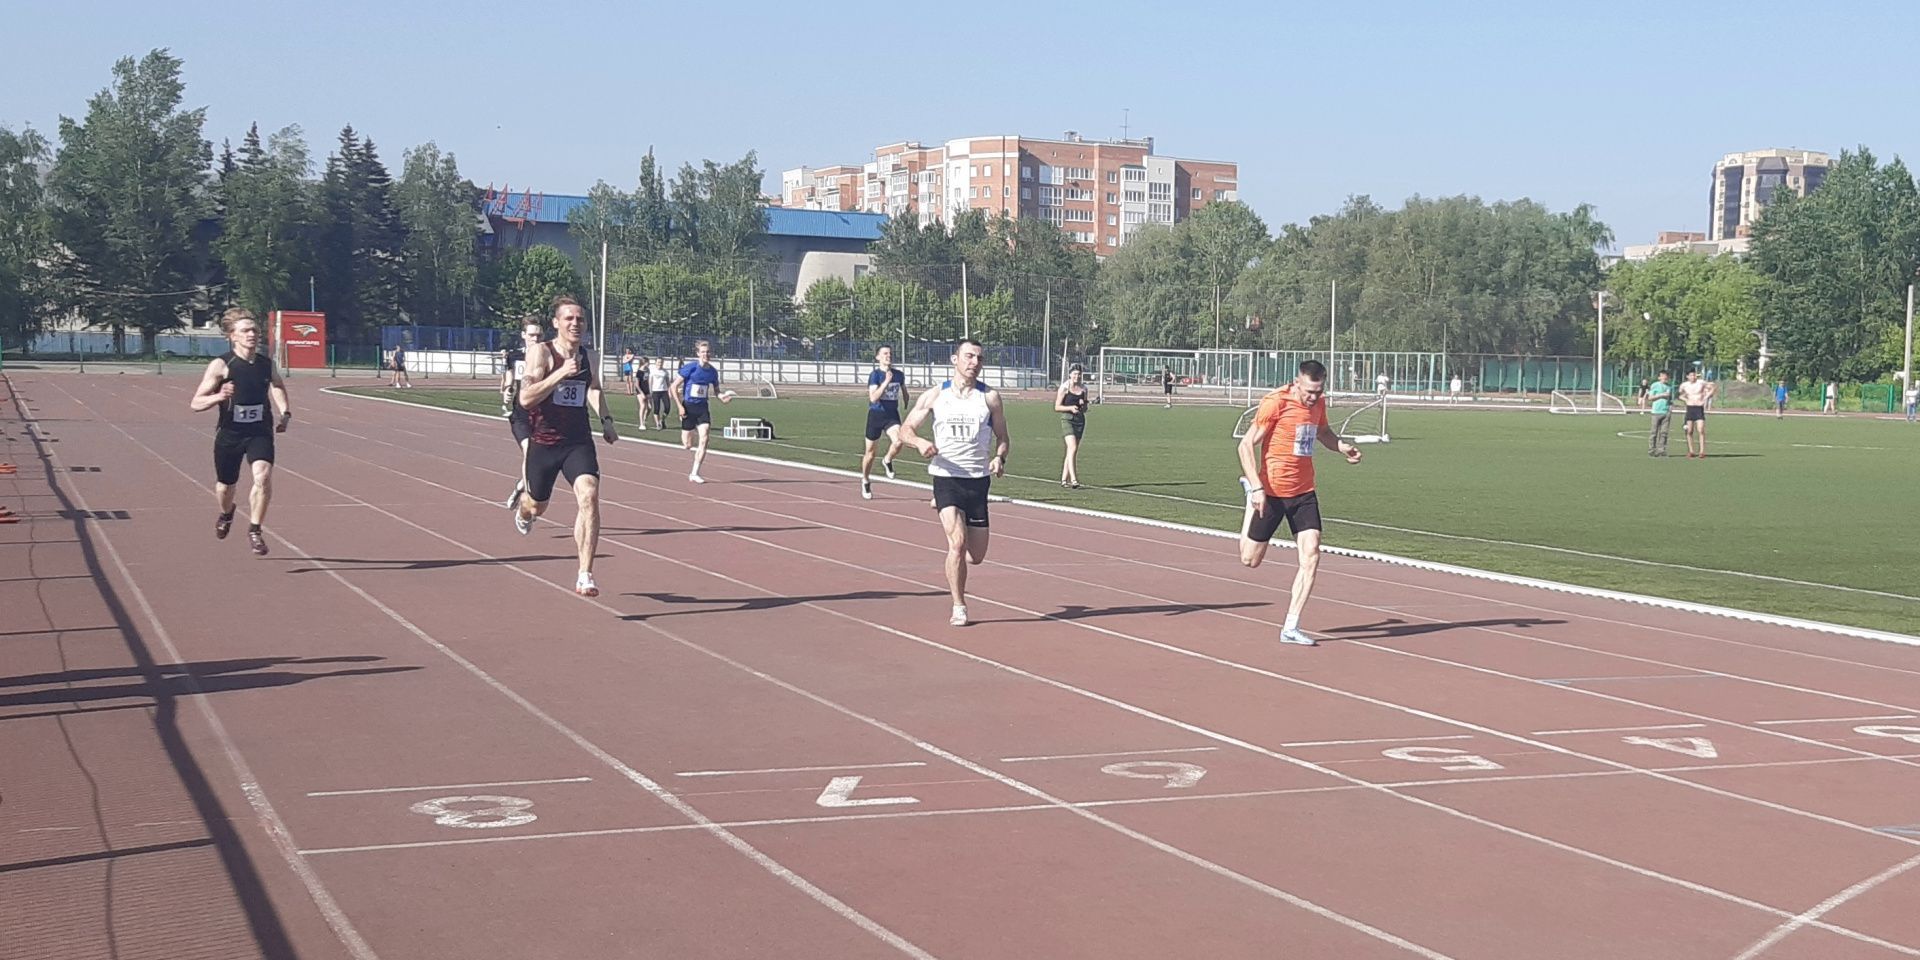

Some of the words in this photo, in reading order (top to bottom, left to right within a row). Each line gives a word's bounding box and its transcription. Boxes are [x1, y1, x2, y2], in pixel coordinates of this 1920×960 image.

[563, 386, 577, 400] 38
[239, 408, 258, 419] 15
[950, 425, 971, 437] 111
[1382, 746, 1505, 772] 5
[1620, 735, 1718, 759] 4
[815, 775, 921, 808] 7
[408, 795, 538, 829] 8
